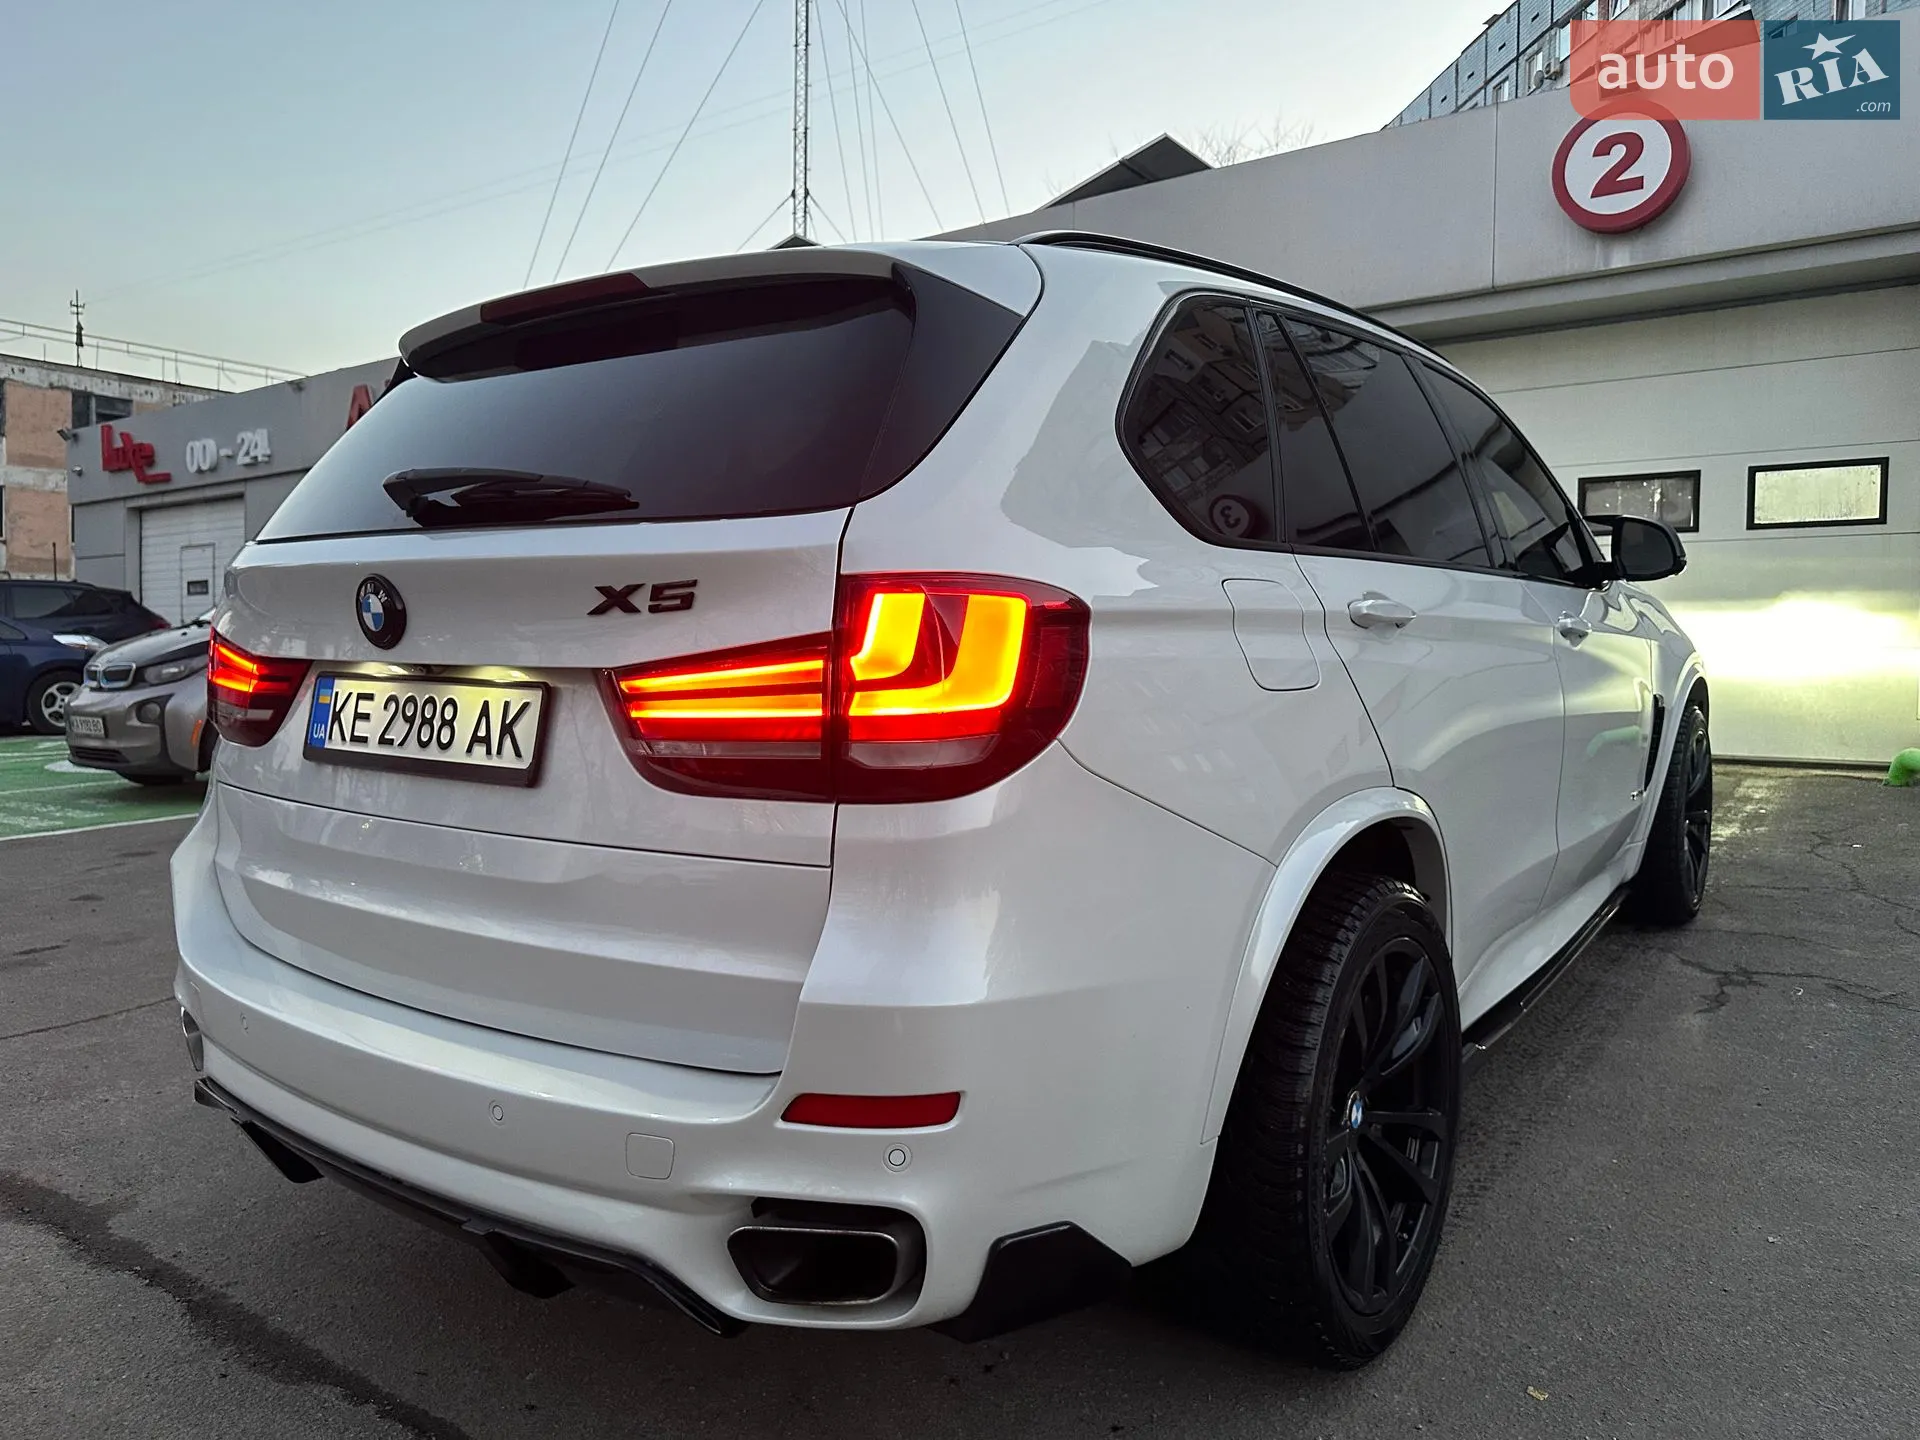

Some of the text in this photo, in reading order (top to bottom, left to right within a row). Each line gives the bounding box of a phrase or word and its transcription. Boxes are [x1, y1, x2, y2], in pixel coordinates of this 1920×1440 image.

[1589, 131, 1645, 199] 2
[586, 579, 698, 616] X5
[313, 723, 325, 740] UA
[328, 691, 531, 759] KE 2988 AK
